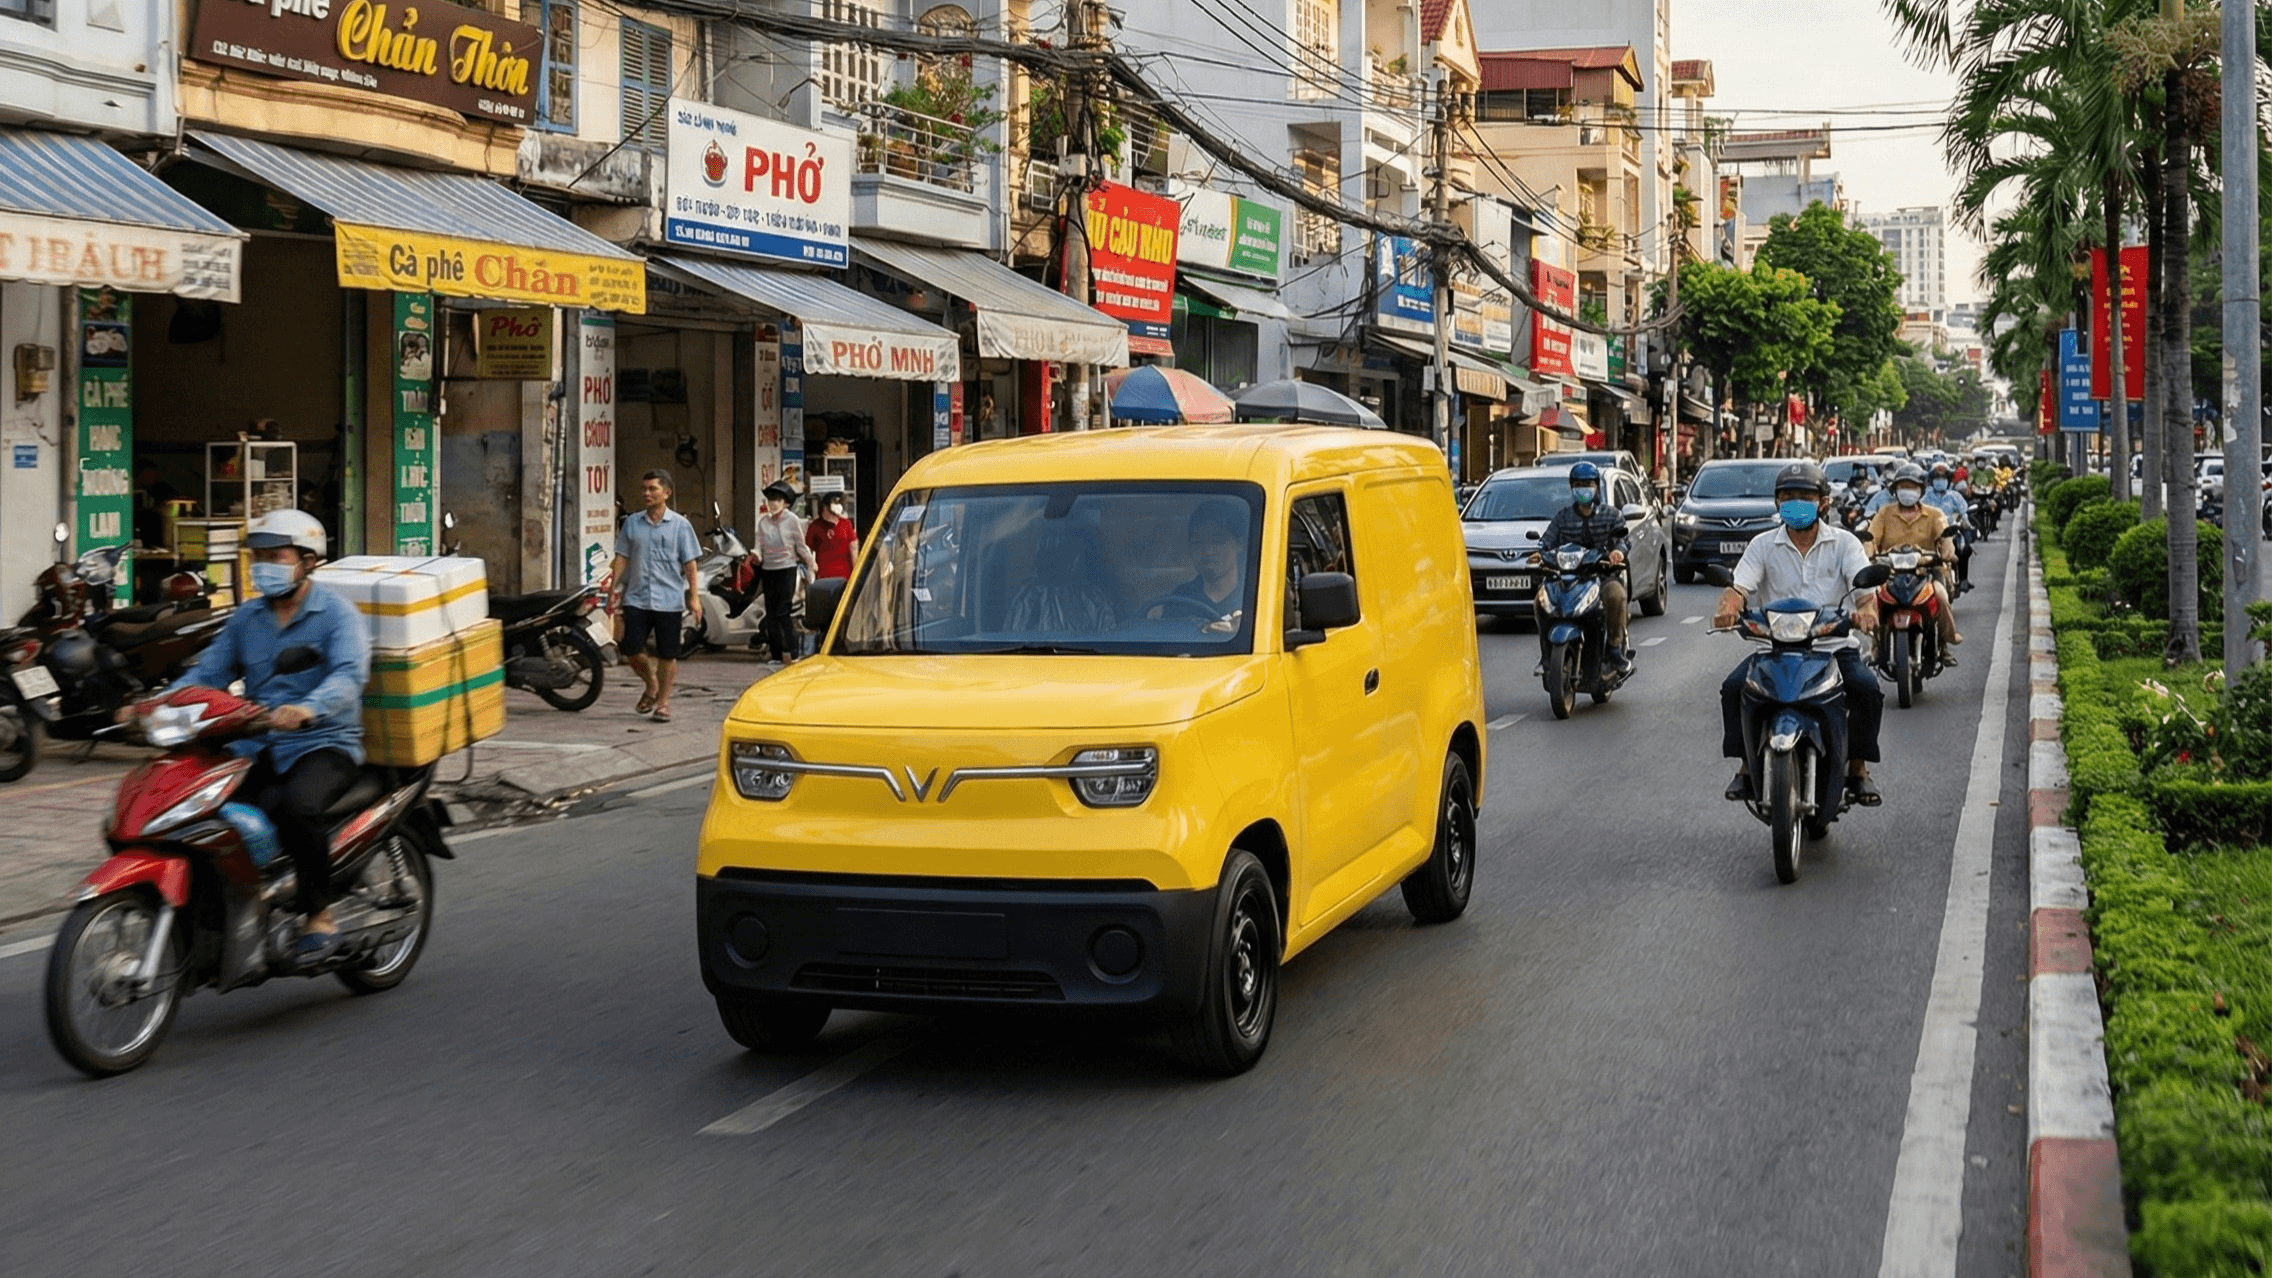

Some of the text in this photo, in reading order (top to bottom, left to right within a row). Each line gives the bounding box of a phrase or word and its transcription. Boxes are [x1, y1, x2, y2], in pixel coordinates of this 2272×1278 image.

[744, 141, 825, 204] PHỞ
[389, 244, 418, 277] Cà
[426, 249, 464, 286] phê
